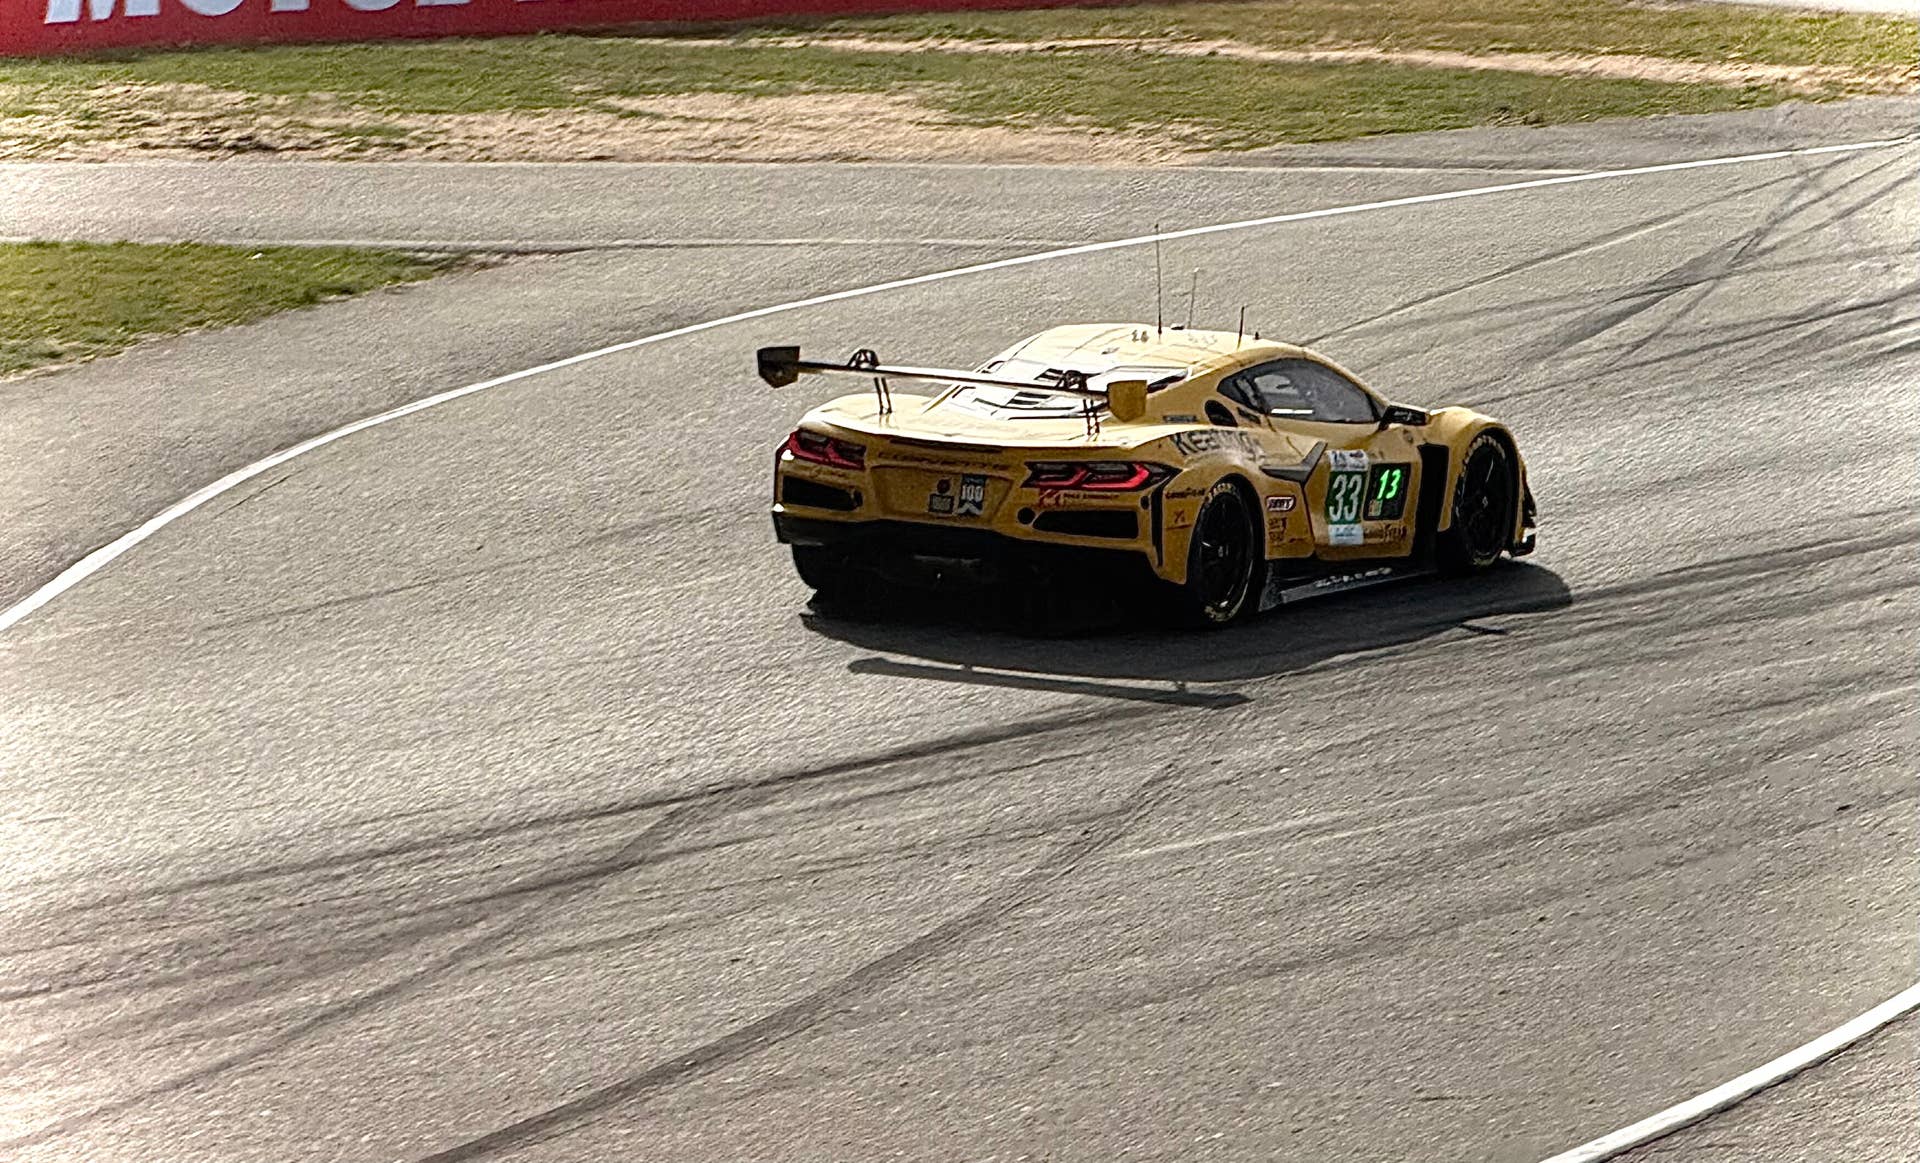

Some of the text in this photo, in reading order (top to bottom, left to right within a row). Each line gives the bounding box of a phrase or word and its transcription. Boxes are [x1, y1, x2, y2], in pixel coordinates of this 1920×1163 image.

[961, 484, 984, 503] 100
[1328, 473, 1363, 522] 33
[1376, 468, 1401, 500] 13
